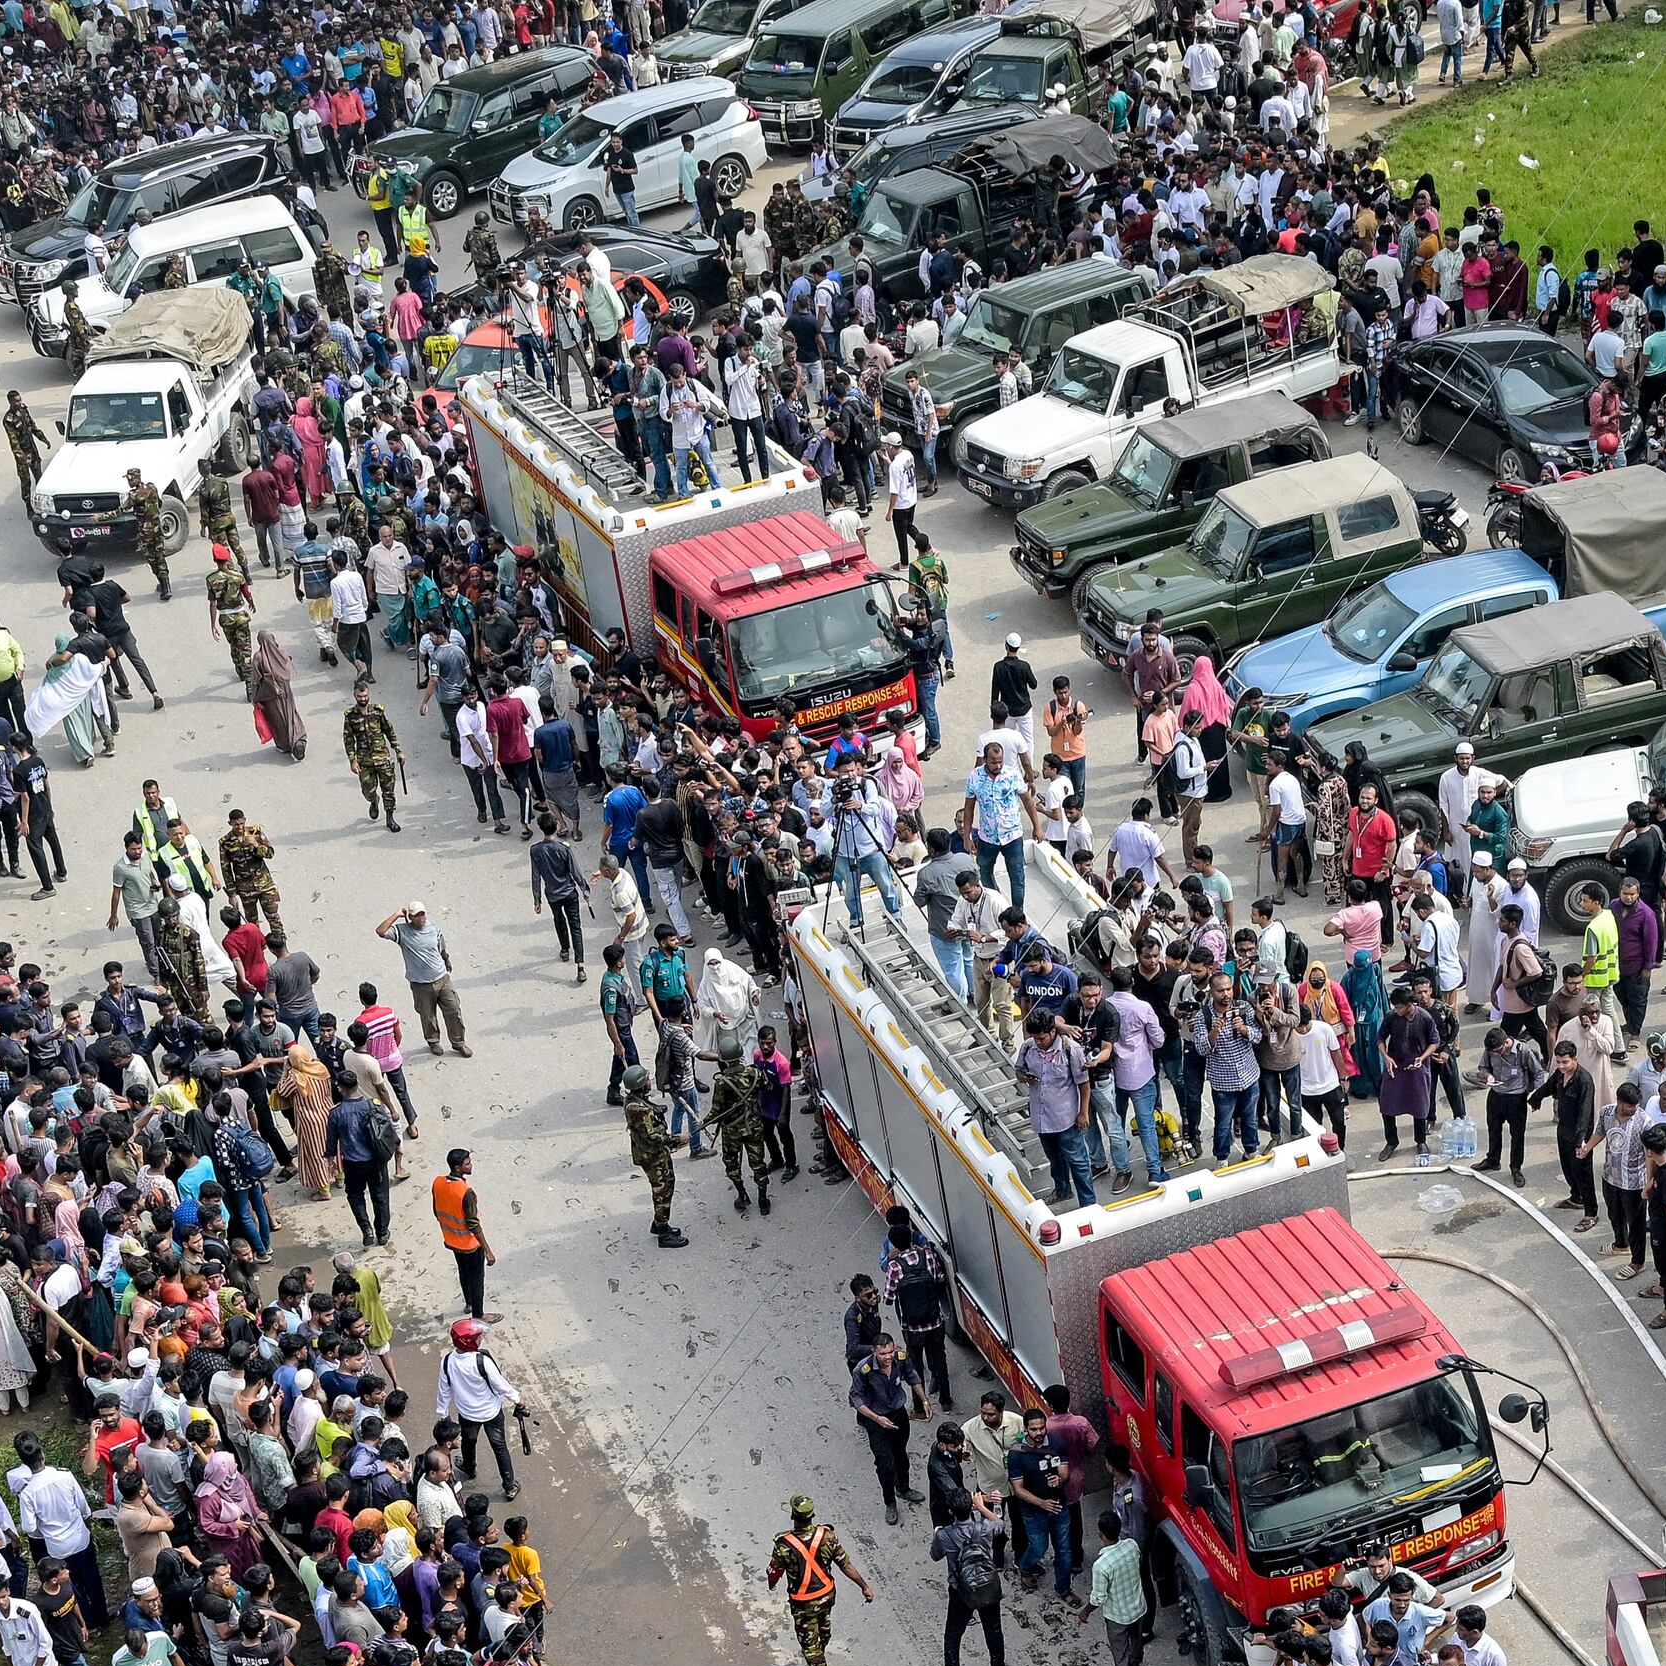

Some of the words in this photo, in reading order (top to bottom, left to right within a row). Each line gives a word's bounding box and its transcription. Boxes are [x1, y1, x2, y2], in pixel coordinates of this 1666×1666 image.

[797, 714, 805, 725] &
[806, 703, 844, 723] RESCUE
[845, 687, 892, 712] RESPONSE
[810, 689, 852, 708] ISUZU
[1025, 985, 1065, 999] LONDON
[1404, 1514, 1481, 1559] RESPONSE
[1269, 1565, 1304, 1578] FVR
[1289, 1573, 1325, 1594] FIRE
